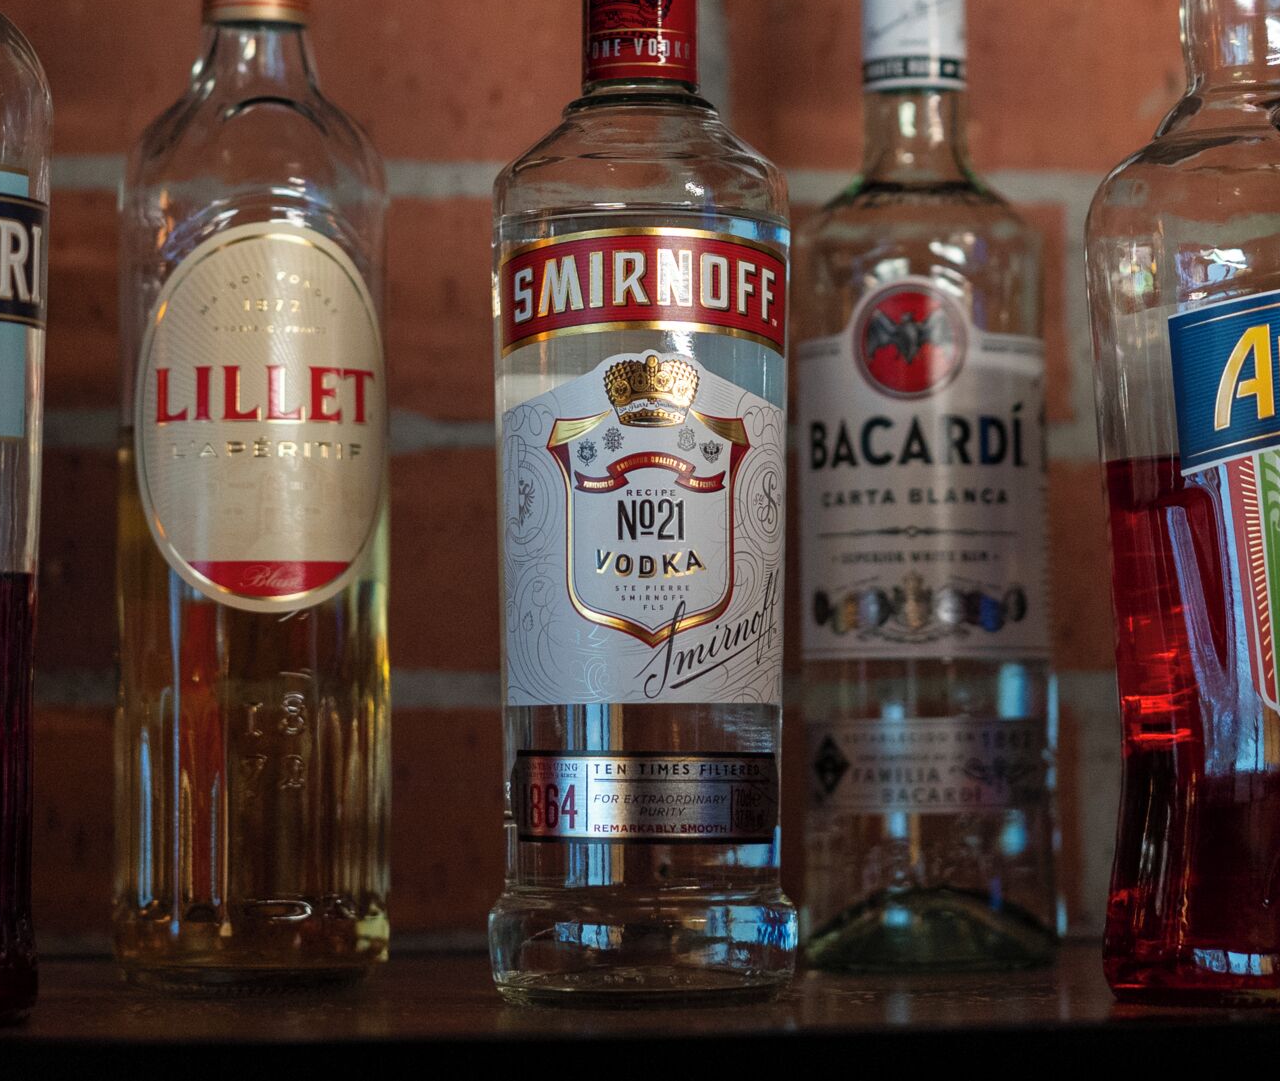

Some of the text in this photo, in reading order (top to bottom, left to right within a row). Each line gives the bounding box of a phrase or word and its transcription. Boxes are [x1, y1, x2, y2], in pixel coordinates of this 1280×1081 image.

[634, 38, 690, 60] VODKA
[514, 248, 775, 324] SMIRNOFF
[156, 365, 374, 424] LILLET
[810, 402, 1027, 471] BACARDÍ
[626, 488, 677, 497] RECIPE
[822, 487, 1008, 507] CARTA BLANCA
[595, 548, 706, 579] VODKA
[633, 569, 780, 699] Smirnoff
[593, 763, 627, 775] TEN
[639, 763, 691, 776] TIMES
[699, 763, 761, 777] FILTERED
[593, 794, 727, 805] FOR EXTRAORDINARY
[639, 806, 686, 817] PURITY
[593, 823, 727, 834] REMARKABLY SMOOTH
